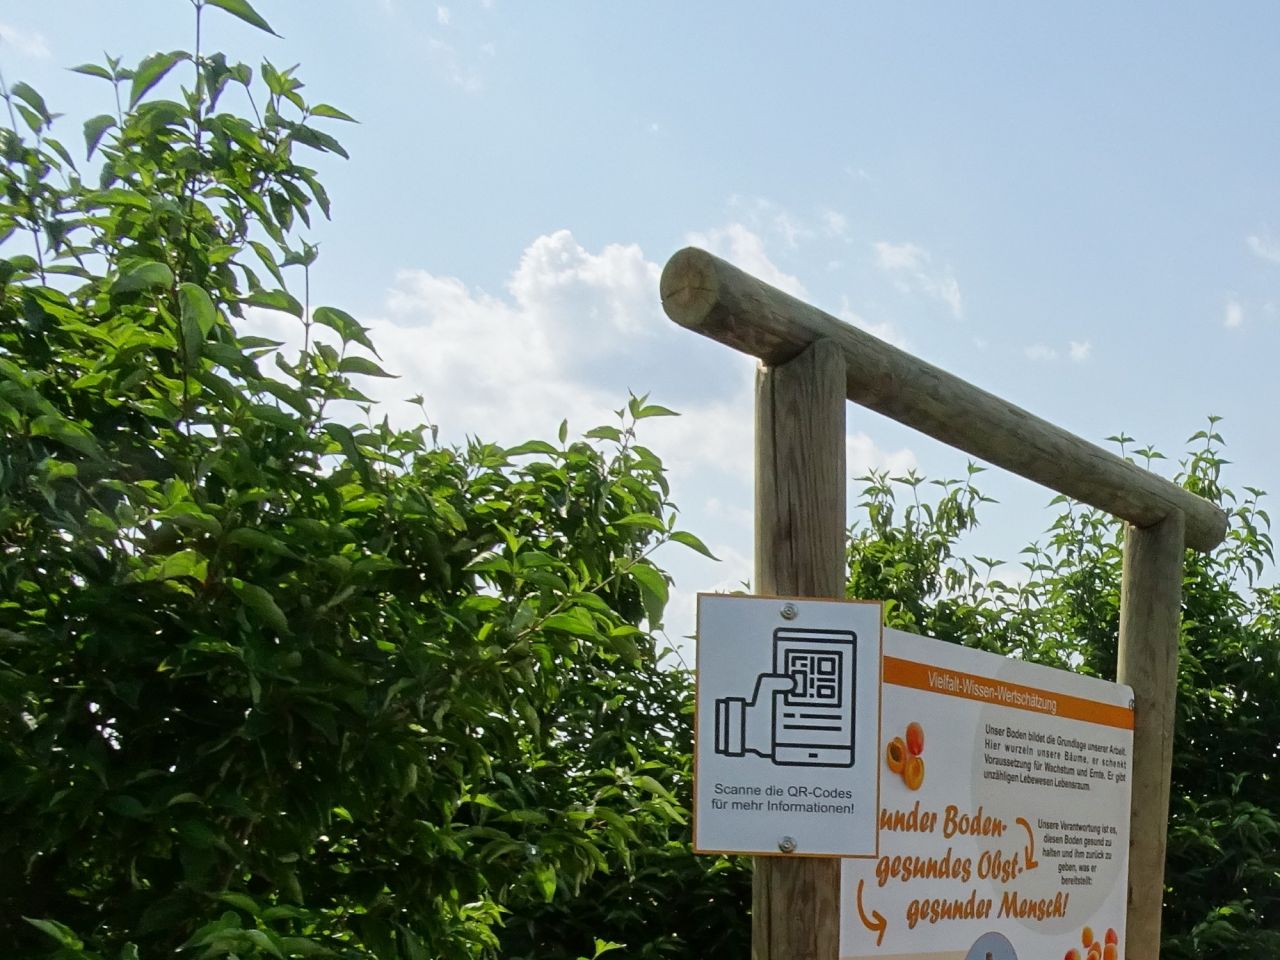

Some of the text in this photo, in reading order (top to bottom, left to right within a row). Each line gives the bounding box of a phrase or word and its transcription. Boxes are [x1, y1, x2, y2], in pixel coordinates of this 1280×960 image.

[928, 671, 1057, 715] Vielfalt-Wissen-Wertschätzung
[985, 724, 1005, 736] Unser
[1006, 728, 1026, 740] Boden
[1028, 731, 1045, 743] bildet
[1047, 734, 1055, 745] die
[1057, 735, 1086, 751] Grundlage
[1088, 742, 1109, 753] unserer
[985, 739, 1000, 750] Hier
[1005, 743, 1033, 756] wurzeln
[1037, 749, 1061, 759] unsere
[1092, 757, 1098, 765] er
[1102, 757, 1126, 769] schenkt
[984, 754, 1031, 771] Voraussetzung
[1034, 759, 1042, 771] für
[1045, 762, 1075, 776] Wachstum
[1077, 767, 1087, 777] und
[1108, 771, 1113, 780] Er
[1115, 772, 1125, 783] gibt
[984, 770, 1019, 784] unzähligen
[1020, 774, 1053, 787] Lebewesen
[714, 783, 852, 799] Scanne die QR-Codes
[712, 799, 854, 814] für mehr Informationen!
[880, 801, 937, 834] under
[1038, 818, 1059, 830] Unsere
[1061, 821, 1100, 835] Verantwortung
[1043, 834, 1112, 849] diesen Boden gesund zu
[1042, 847, 1112, 860] halten und ihm zurück zu
[876, 848, 972, 887] gesundes
[1058, 862, 1096, 874] geben, was er
[906, 890, 1069, 929] gesunder Mensch!
